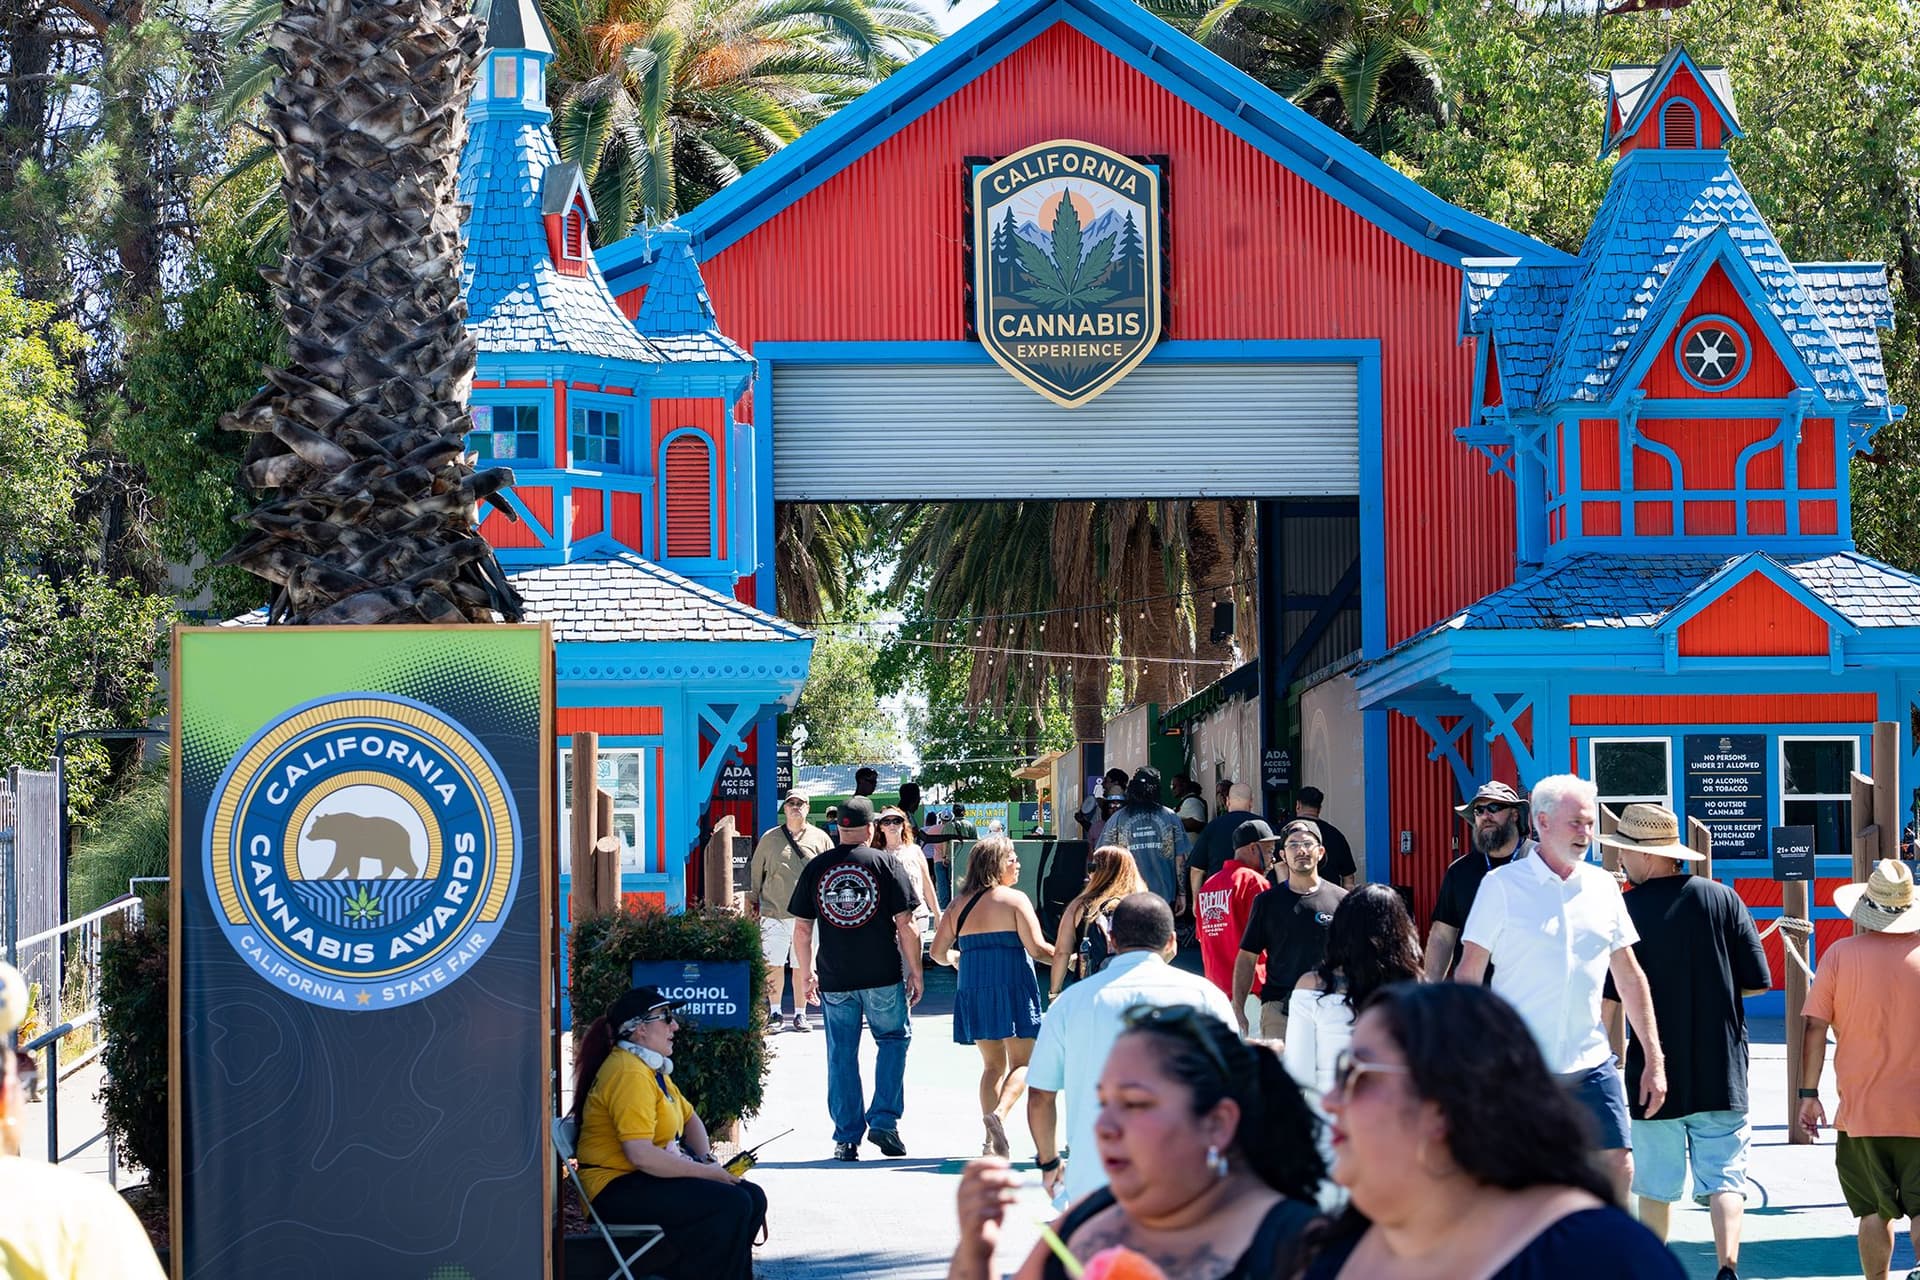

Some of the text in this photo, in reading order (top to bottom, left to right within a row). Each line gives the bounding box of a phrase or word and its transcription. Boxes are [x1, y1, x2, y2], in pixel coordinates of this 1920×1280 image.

[993, 153, 1137, 195] CALIFORNIA
[998, 312, 1140, 337] CANNABIS
[1017, 343, 1122, 358] EXPERIENCE
[1265, 750, 1289, 759] ADA
[266, 736, 457, 805] CALIFORNIA
[723, 767, 752, 777] ADA
[776, 767, 789, 775] DA
[721, 779, 755, 787] ACCESS
[1715, 777, 1749, 785] ALCOHOL
[1707, 808, 1745, 816] CANNABIS
[1776, 845, 1810, 854] 21+ ONLY
[732, 856, 749, 864] ONLY
[250, 832, 475, 963] CANNABIS AWARDS
[1198, 889, 1233, 919] FAMILY
[240, 933, 487, 1002] CALIFORNIA STATE FAIR
